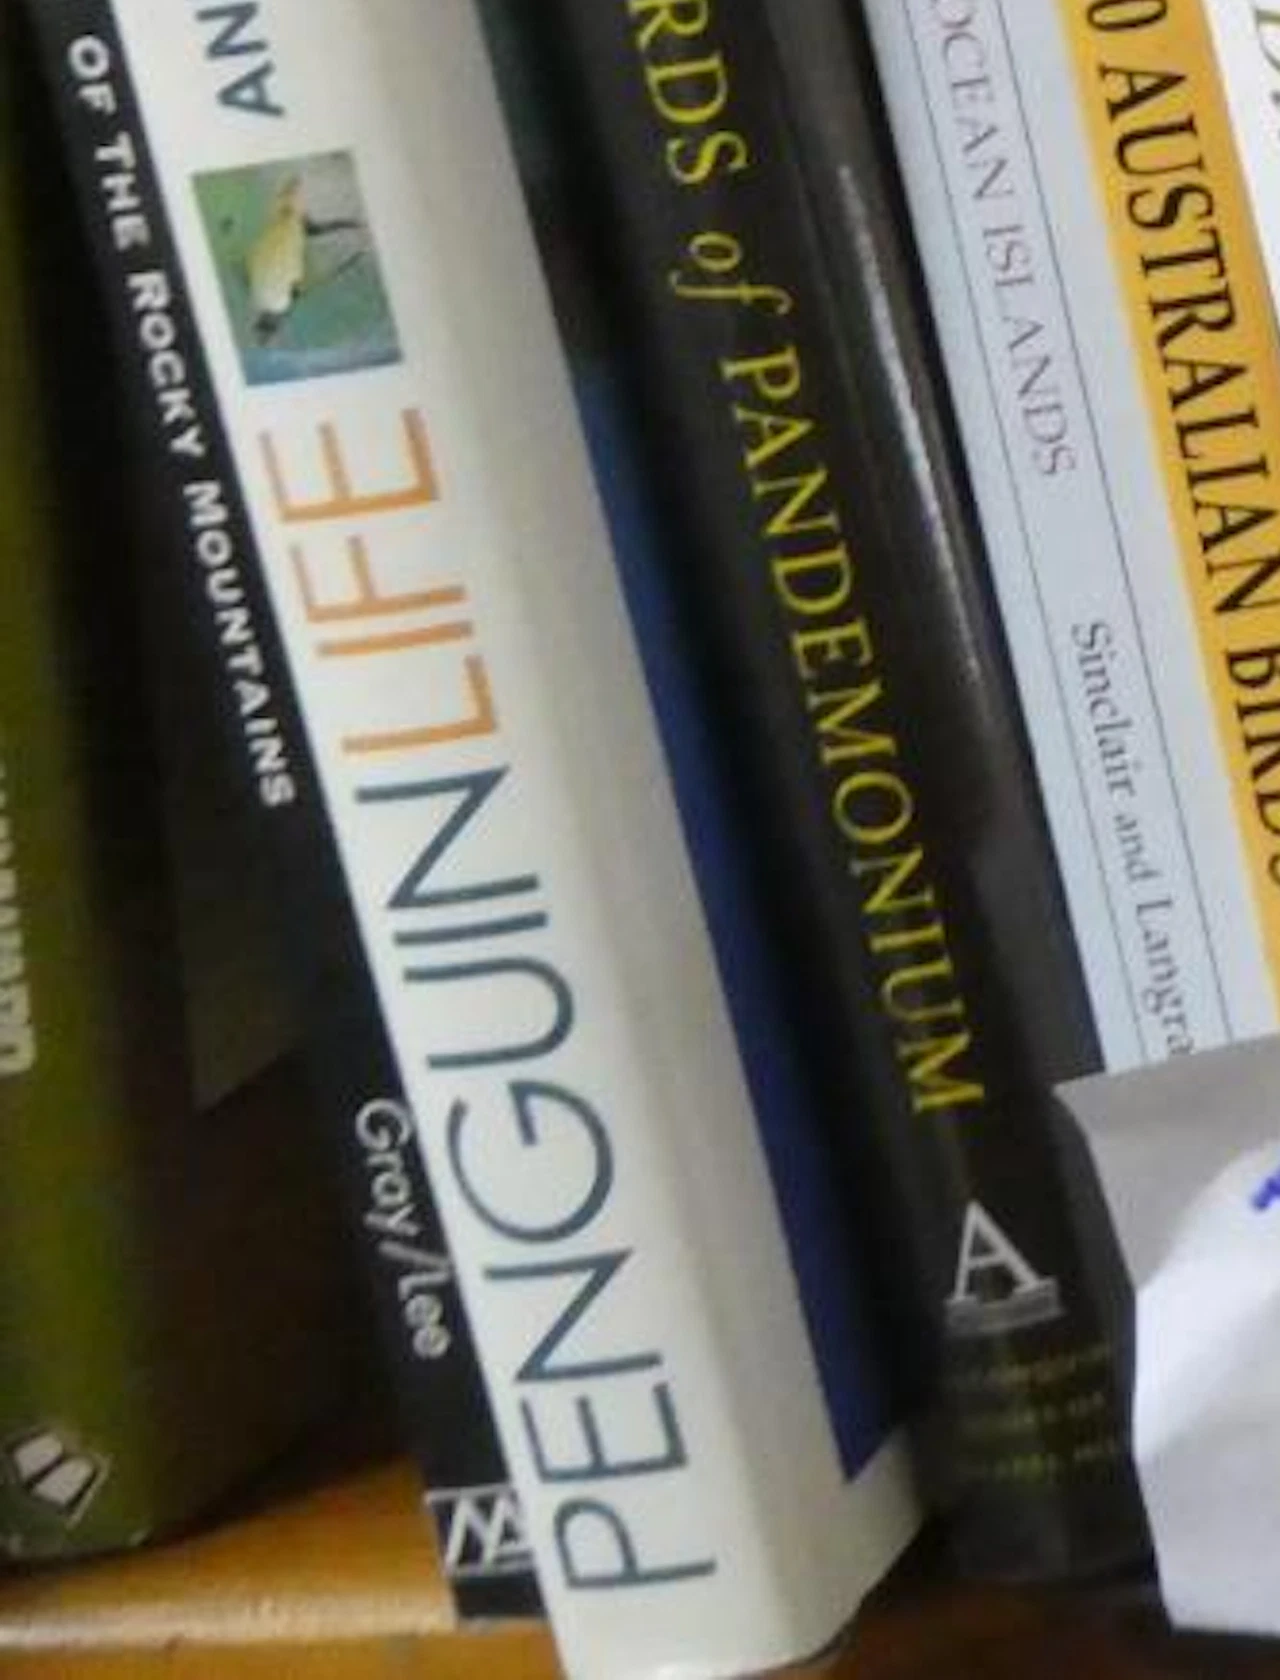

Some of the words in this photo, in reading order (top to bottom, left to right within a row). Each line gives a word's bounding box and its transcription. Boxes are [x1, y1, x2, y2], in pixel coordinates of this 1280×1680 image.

[669, 233, 792, 316] of
[984, 225, 1077, 477] ISLANDS
[68, 34, 117, 114] OF
[95, 131, 149, 251] THE
[127, 270, 206, 457] ROCKY
[183, 480, 296, 808] MOUNTAINS
[719, 344, 986, 1114] PANDEMONIUM
[1071, 620, 1138, 796] Sinclair
[1114, 811, 1156, 882] and
